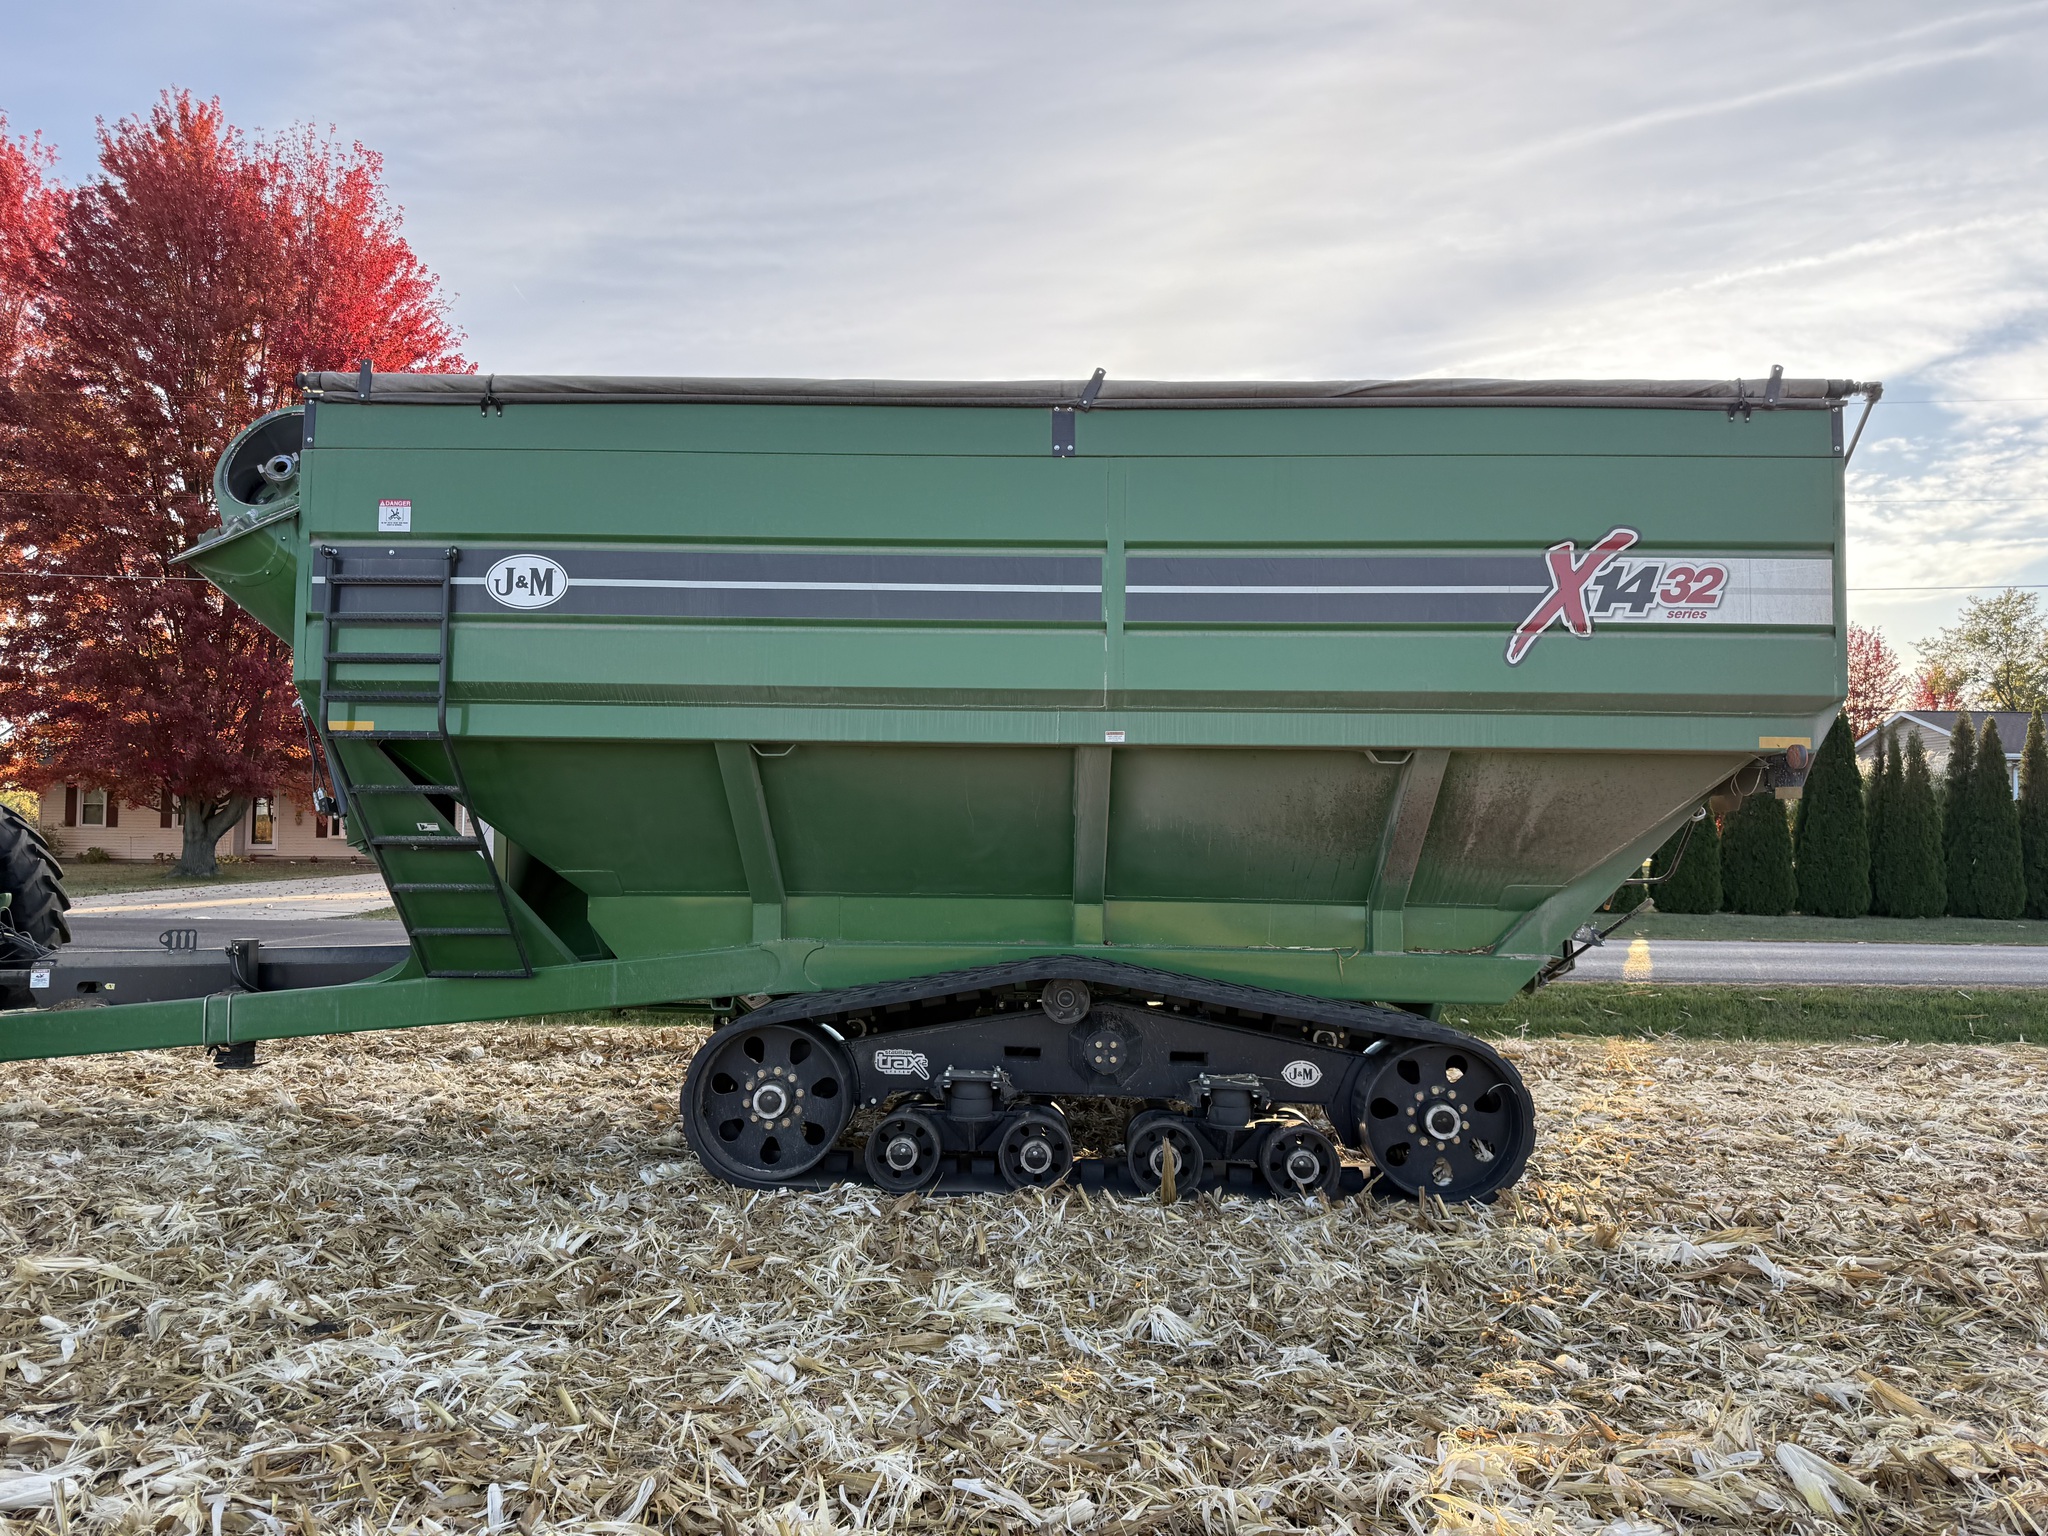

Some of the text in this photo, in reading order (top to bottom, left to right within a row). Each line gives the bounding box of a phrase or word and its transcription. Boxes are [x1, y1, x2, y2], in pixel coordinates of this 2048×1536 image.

[494, 567, 555, 597] J&M
[1666, 608, 1708, 619] series
[1289, 1067, 1313, 1081] J&M
